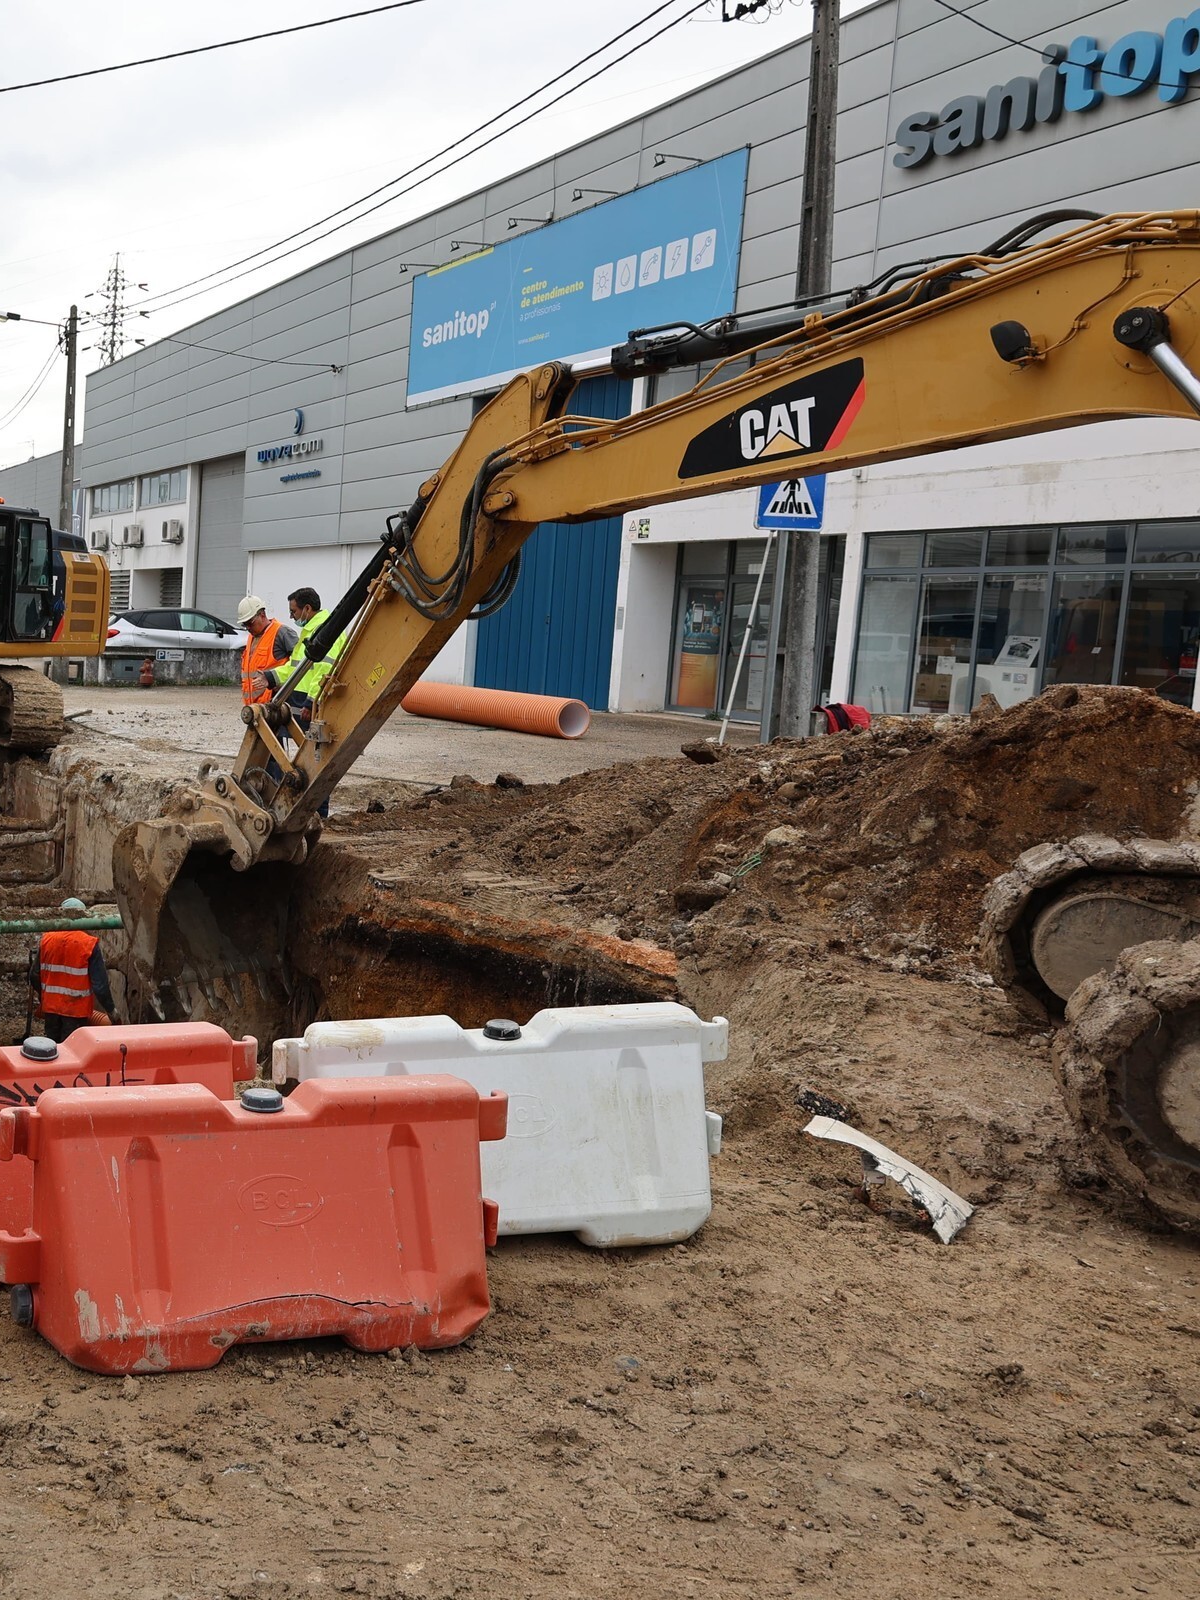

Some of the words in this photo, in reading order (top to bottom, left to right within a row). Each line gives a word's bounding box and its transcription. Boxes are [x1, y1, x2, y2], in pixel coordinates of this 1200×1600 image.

[893, 8, 1200, 169] sanitop
[520, 296, 531, 308] de
[532, 280, 584, 305] atendimento
[521, 280, 548, 295] centro
[525, 303, 561, 322] profissionais
[423, 310, 489, 347] sanitop
[739, 396, 816, 460] CAT
[252, 1189, 313, 1211] BCL
